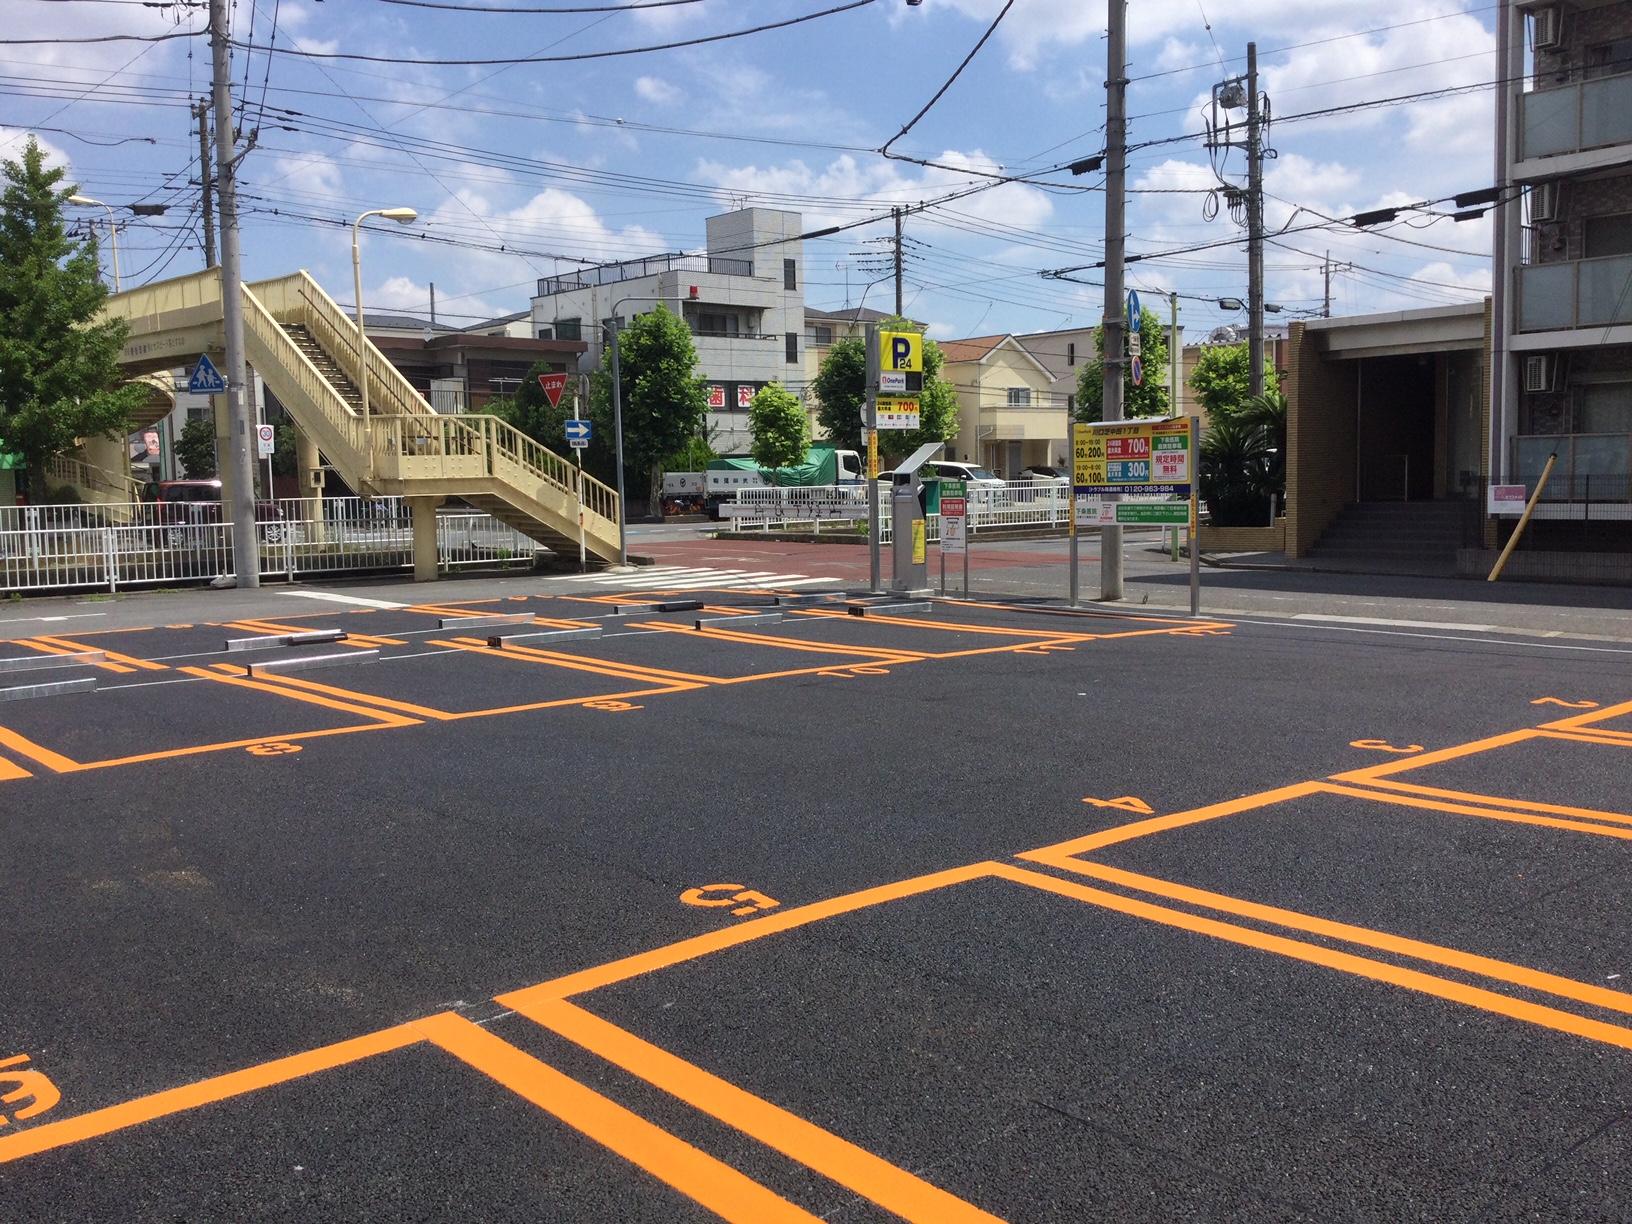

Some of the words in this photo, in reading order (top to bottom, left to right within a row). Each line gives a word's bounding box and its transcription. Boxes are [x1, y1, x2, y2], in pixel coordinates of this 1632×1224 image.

[892, 337, 911, 370] P
[899, 359, 912, 370] 24
[545, 381, 563, 389] 止まれ
[1155, 454, 1185, 464] 規定時間
[1162, 465, 1177, 475] 無料
[1081, 795, 1156, 815] 4
[678, 882, 782, 917] 5
